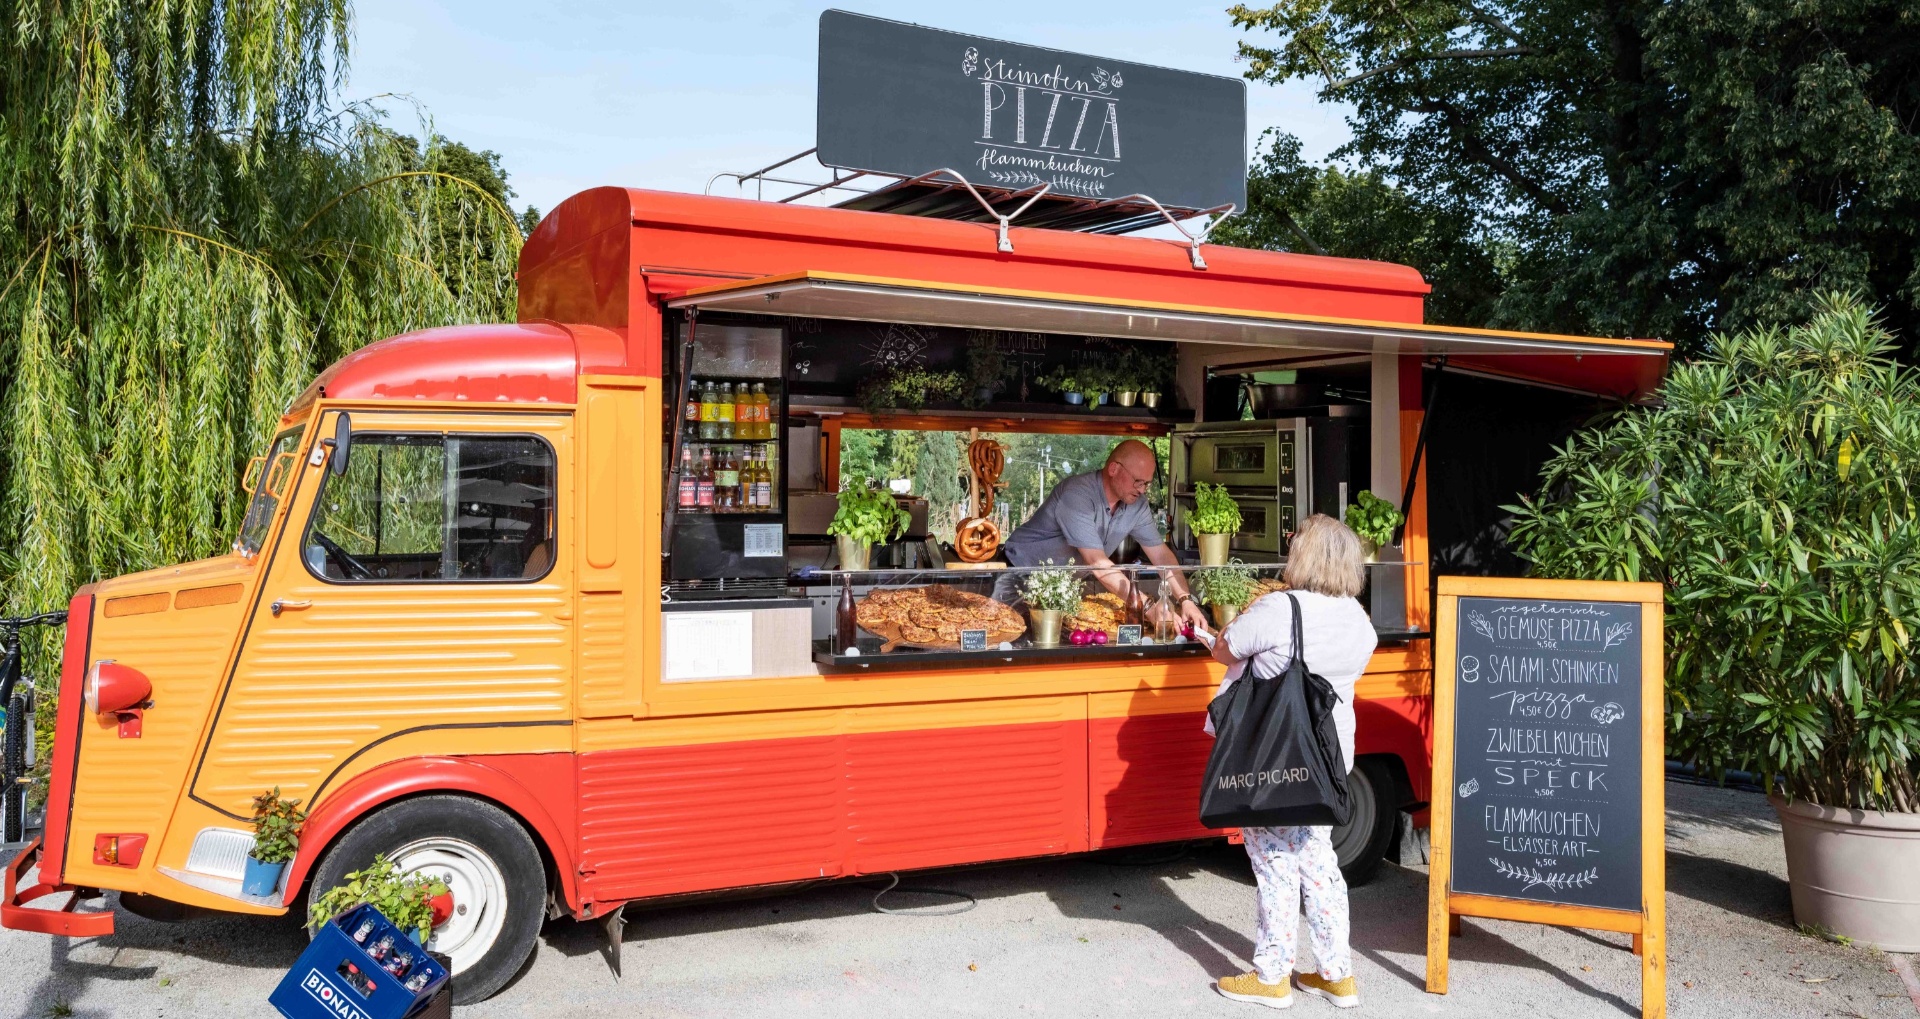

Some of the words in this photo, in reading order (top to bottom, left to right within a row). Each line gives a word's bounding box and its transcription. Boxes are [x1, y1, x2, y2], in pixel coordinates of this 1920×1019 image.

[984, 58, 1113, 95] Steinofen
[981, 82, 1121, 158] PIZZA
[976, 149, 1115, 178] flammkuchen
[1491, 603, 1611, 617] vegetarische
[1561, 618, 1601, 642] PIZZA
[1536, 640, 1558, 650] 4,50€
[1487, 654, 1545, 684] SALAMI
[1550, 658, 1619, 685] SCHINKEN
[1490, 688, 1596, 719] pizza
[1519, 705, 1542, 717] 4,50€
[1486, 728, 1609, 758] ZWIEBELKUCHEN
[1526, 757, 1567, 768] mit
[1218, 772, 1255, 790] MARC
[1258, 767, 1309, 786] PICARD
[1495, 766, 1609, 792] SPECK
[1534, 788, 1555, 797] 4,50€
[1485, 805, 1600, 837] FLAMMKUCHEN
[1503, 835, 1559, 856] ELSÄSSER
[1561, 841, 1588, 858] ART
[1535, 858, 1557, 868] 4,50€
[306, 974, 366, 1019] BIONAD
